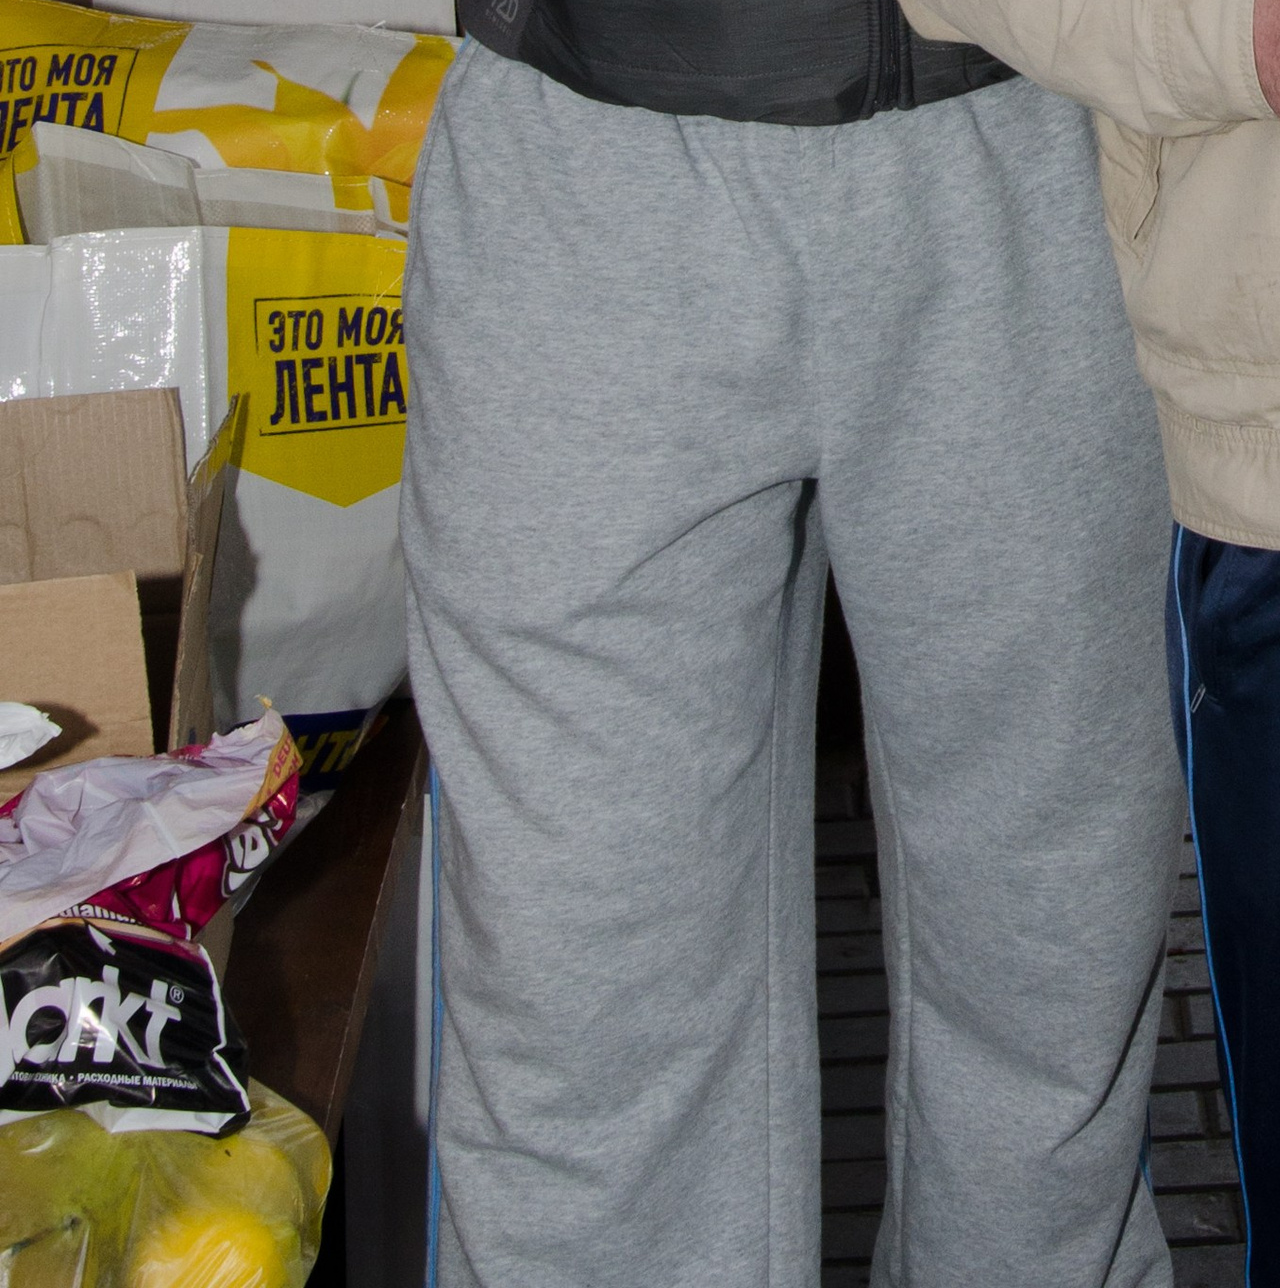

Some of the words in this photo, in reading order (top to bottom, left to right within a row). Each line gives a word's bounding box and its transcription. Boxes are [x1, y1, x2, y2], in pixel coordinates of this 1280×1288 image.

[0, 56, 37, 94] ТО
[46, 53, 118, 87] МОЯ
[269, 308, 324, 353] ЭТО
[337, 306, 405, 348] МОЯ
[270, 352, 407, 426] ЛЕНТА
[77, 1073, 141, 1086] РАСХОДНЫЕ
